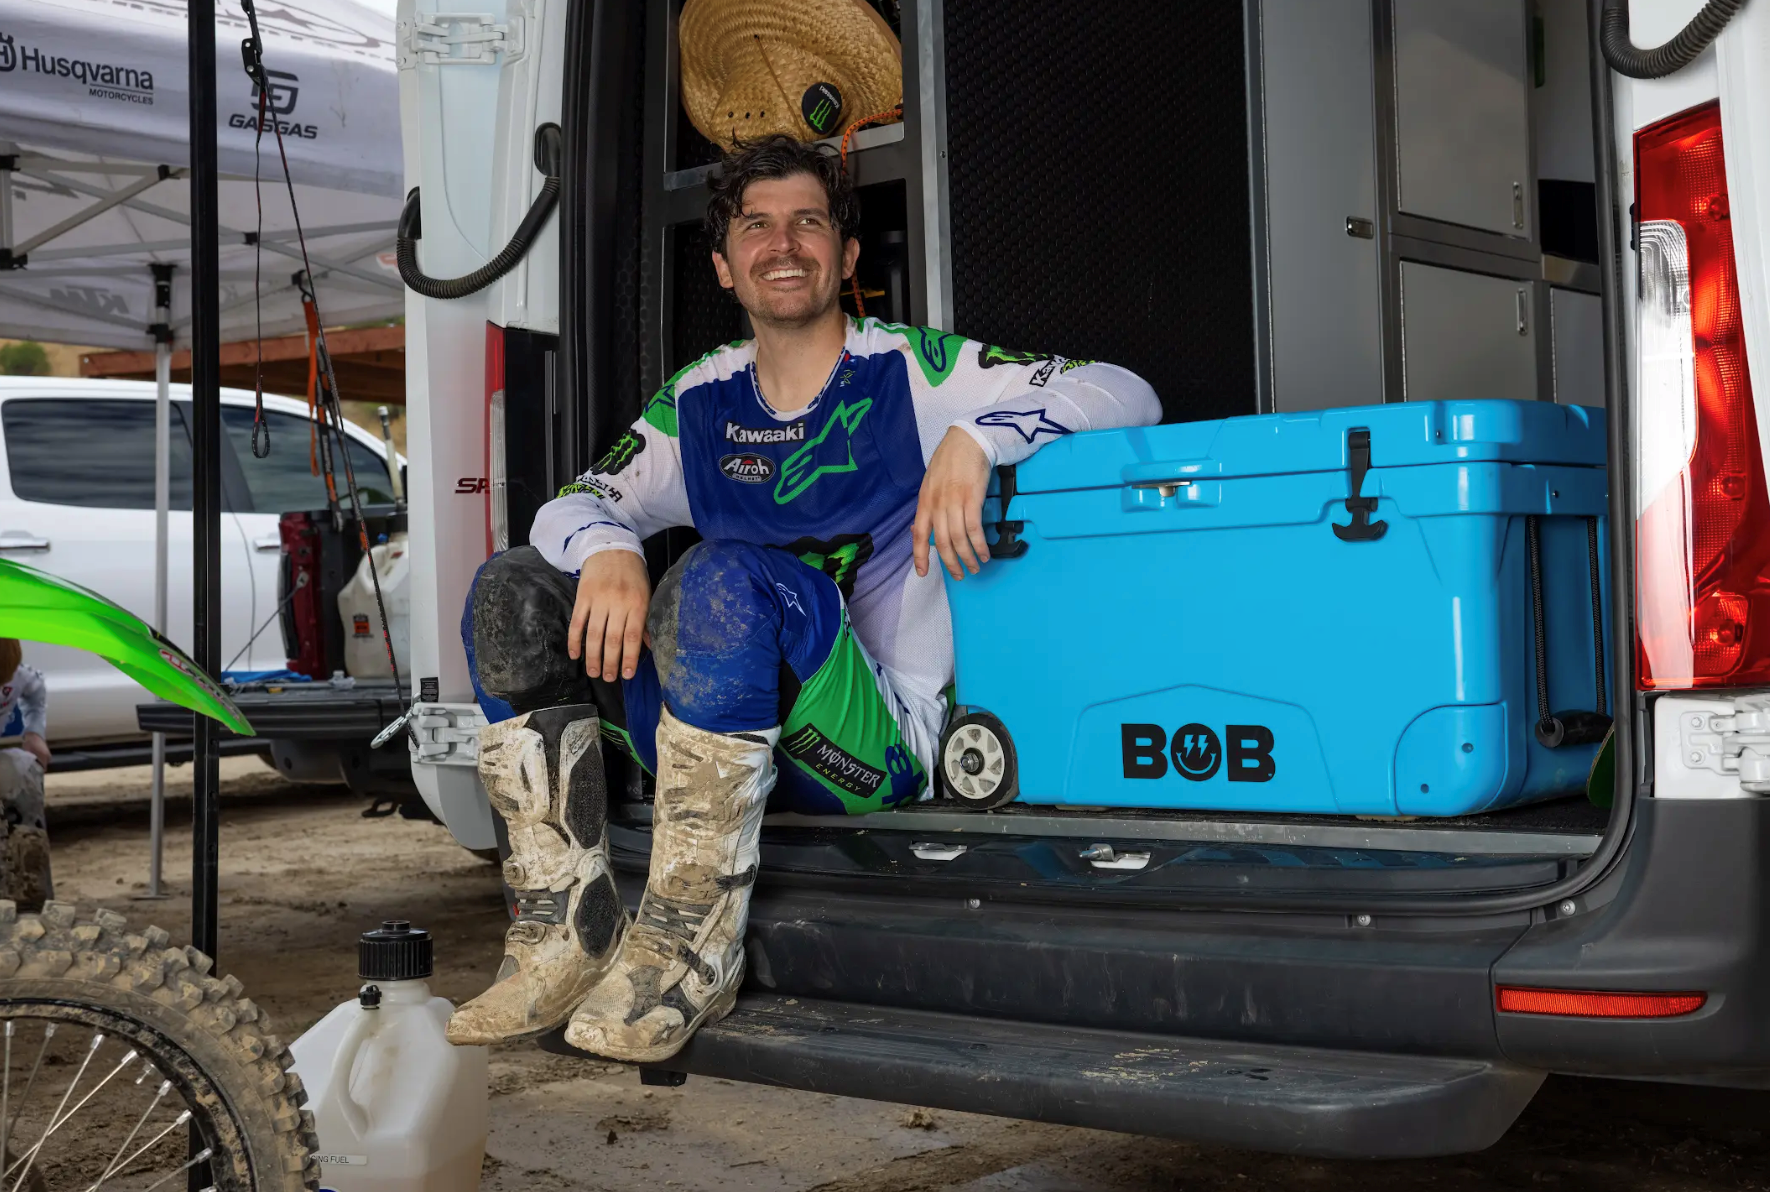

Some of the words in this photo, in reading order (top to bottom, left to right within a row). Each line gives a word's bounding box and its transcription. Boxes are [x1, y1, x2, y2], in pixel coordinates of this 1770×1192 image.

[20, 45, 154, 90] Husqvarna
[89, 88, 154, 106] MOTORCYCLES
[228, 113, 318, 139] GASGAS
[723, 457, 770, 475] Airoh
[1121, 722, 1276, 783] BOB
[815, 763, 861, 791] ENERGY
[330, 1155, 350, 1164] FUEL
